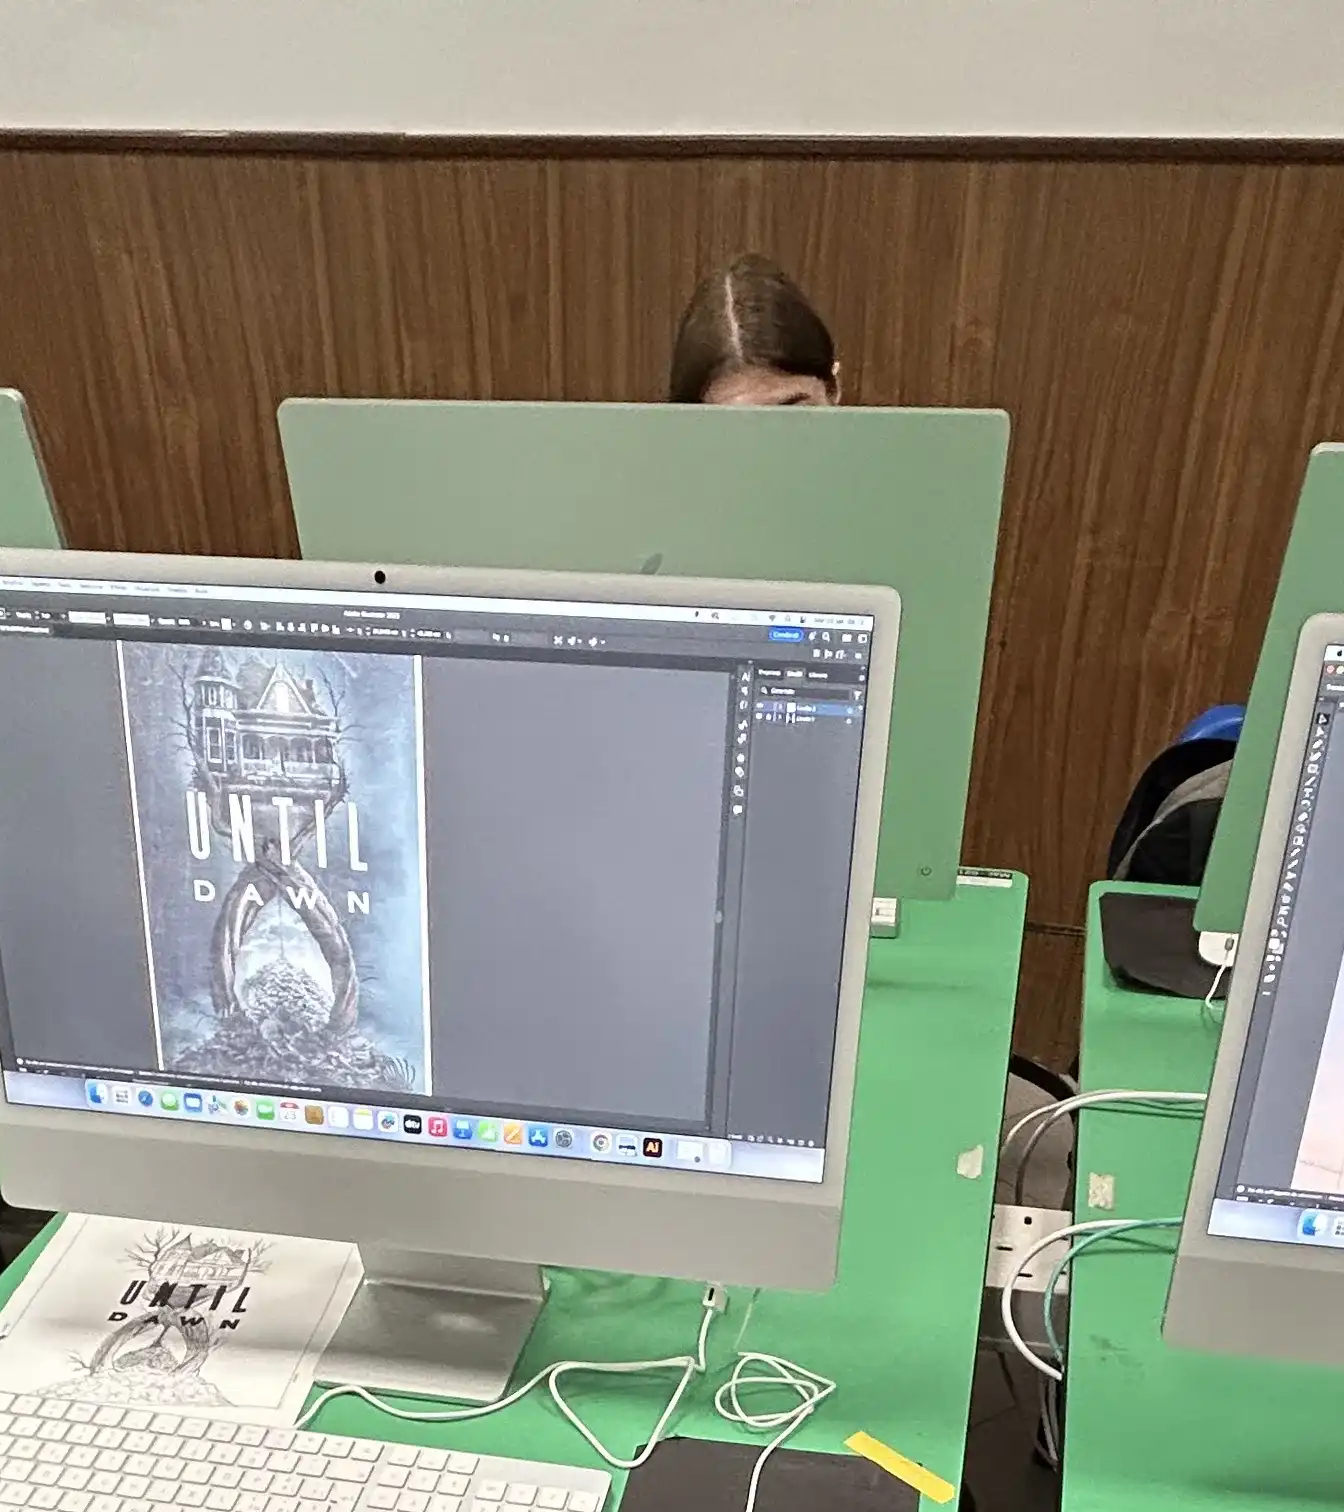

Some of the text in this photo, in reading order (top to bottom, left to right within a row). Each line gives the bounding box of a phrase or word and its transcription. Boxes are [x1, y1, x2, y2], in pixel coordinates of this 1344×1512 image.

[186, 790, 368, 871] UNTIL
[193, 879, 370, 914] DAWN
[120, 1280, 251, 1313] UNTIL
[108, 1311, 241, 1329] DAWN
